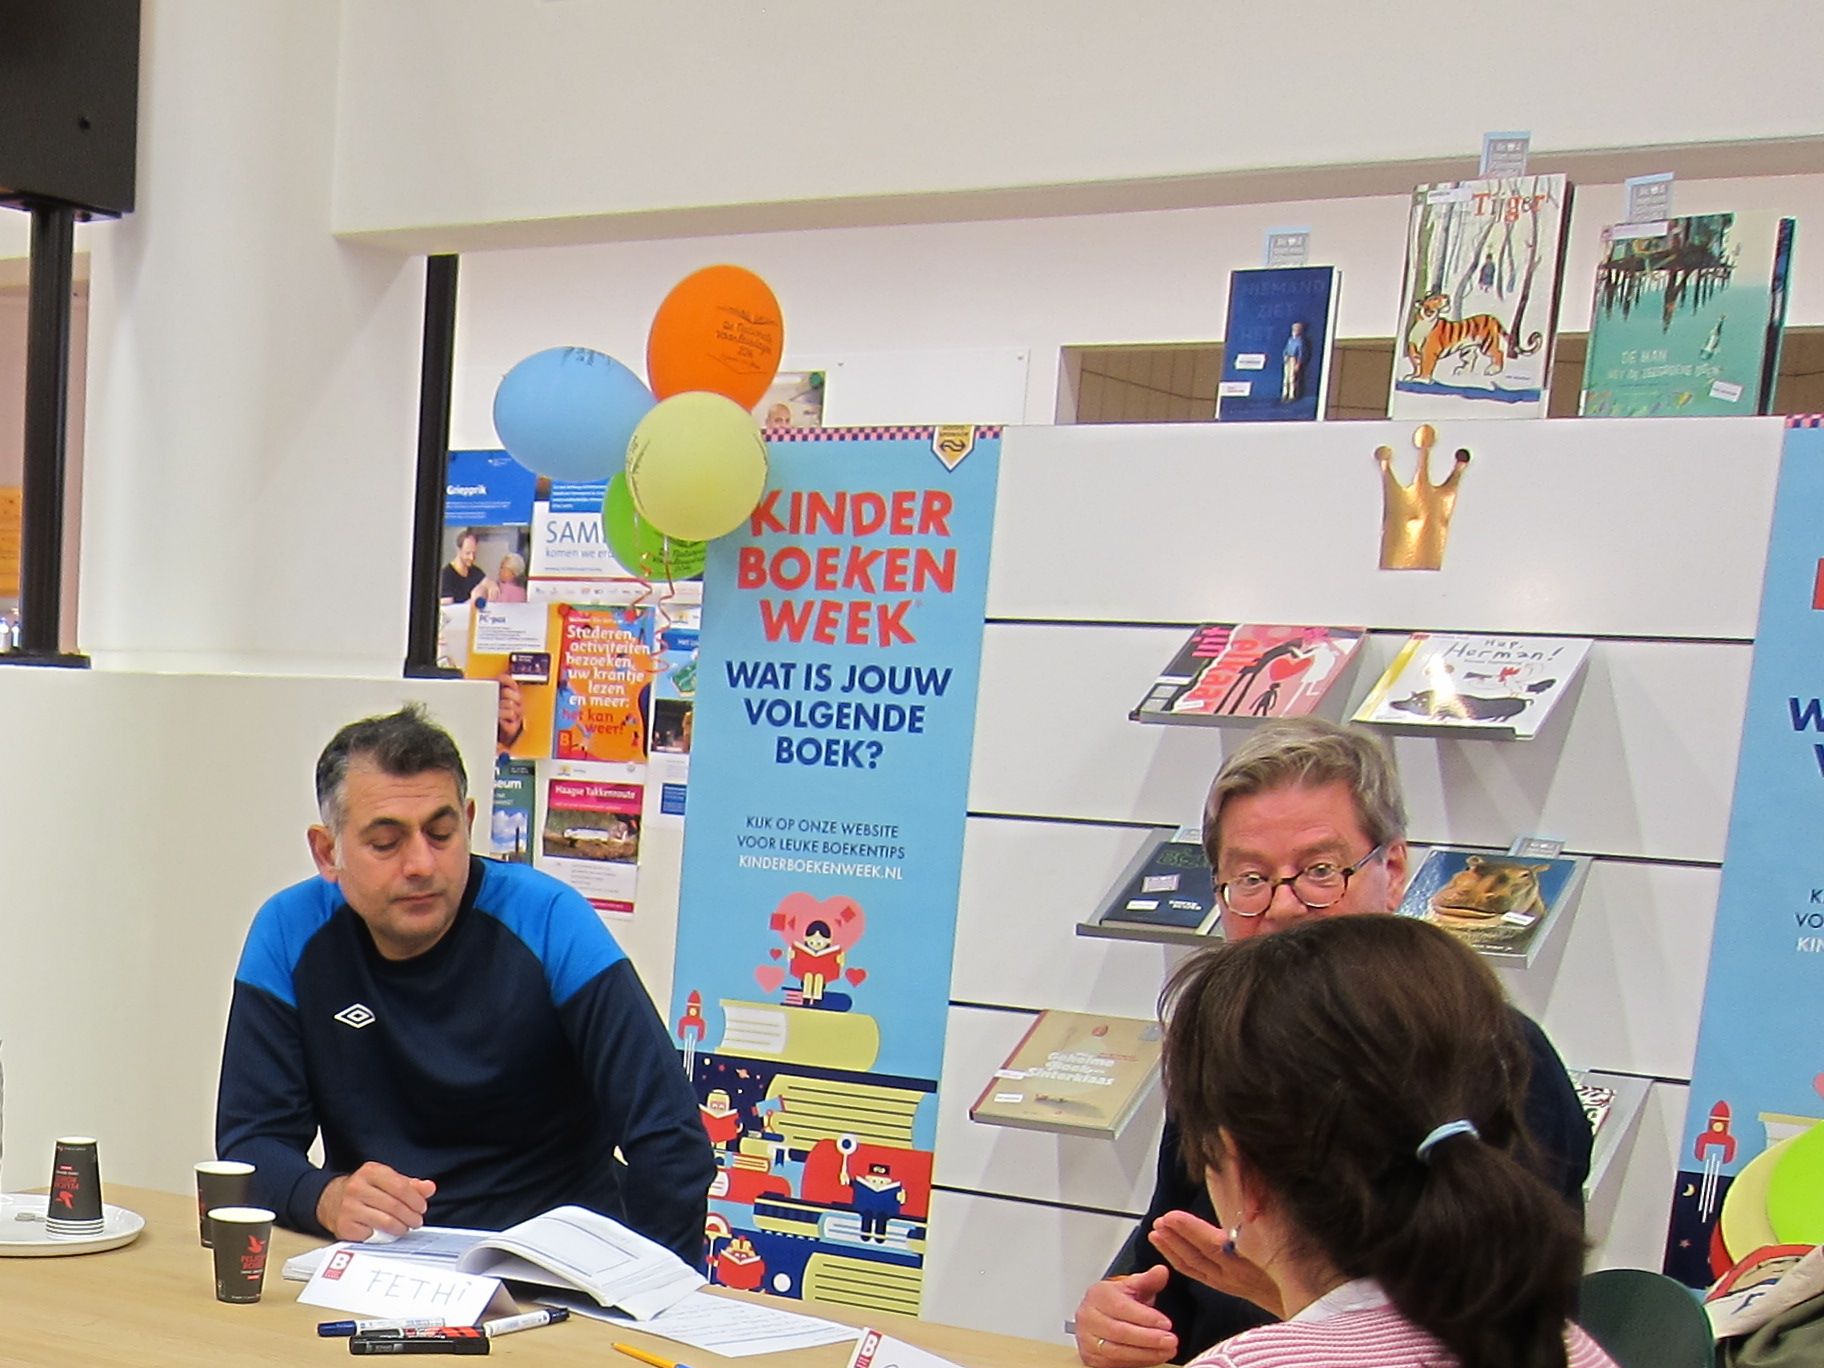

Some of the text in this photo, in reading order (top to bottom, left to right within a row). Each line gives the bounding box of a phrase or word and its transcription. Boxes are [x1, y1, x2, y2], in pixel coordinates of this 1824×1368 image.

[1472, 191, 1545, 223] Tijger
[750, 489, 954, 538] KINDER
[546, 520, 606, 543] SAM
[737, 545, 957, 594] BOEKEN
[567, 625, 637, 643] Studeren,
[759, 599, 917, 648] WEEK
[570, 640, 650, 656] activiteiten
[1443, 643, 1564, 662] Herman!
[568, 668, 646, 684] uw krantje
[726, 660, 953, 697] WAT IS JOUW
[588, 681, 625, 695] lezen
[569, 695, 587, 707] en
[588, 709, 614, 722] kan
[743, 698, 925, 734] VOLGENDE
[775, 736, 884, 769] BOEK?
[746, 815, 899, 838] KIJK OP ONZE WEBSITE
[736, 835, 905, 859] VOOR LEUKE BOEKENTIPS
[738, 855, 904, 881] KINDERBOEKENWEEK.NL
[329, 1252, 351, 1270] B
[861, 1334, 879, 1358] B
